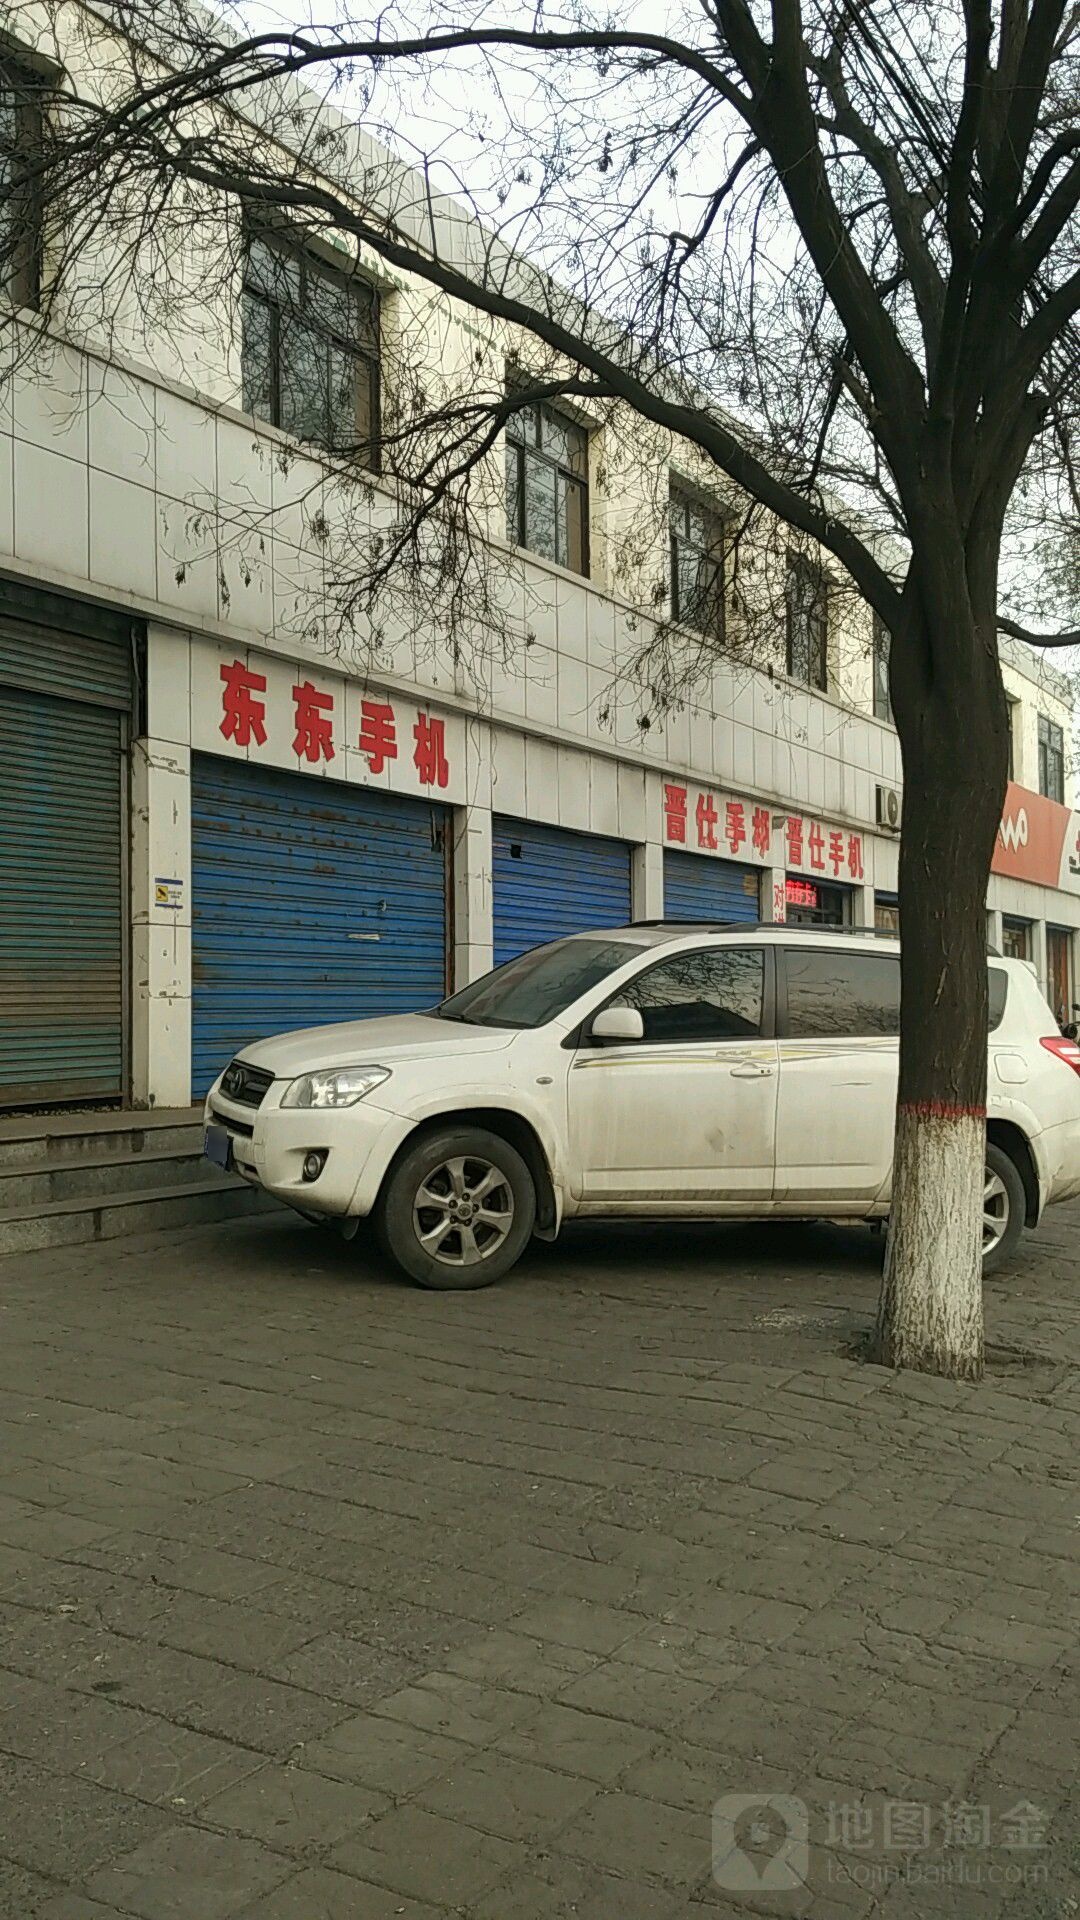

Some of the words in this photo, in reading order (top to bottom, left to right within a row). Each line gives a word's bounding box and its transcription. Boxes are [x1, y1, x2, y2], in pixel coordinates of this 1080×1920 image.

[220, 660, 449, 788] 东东手机
[786, 816, 864, 879] 晋仕手机
